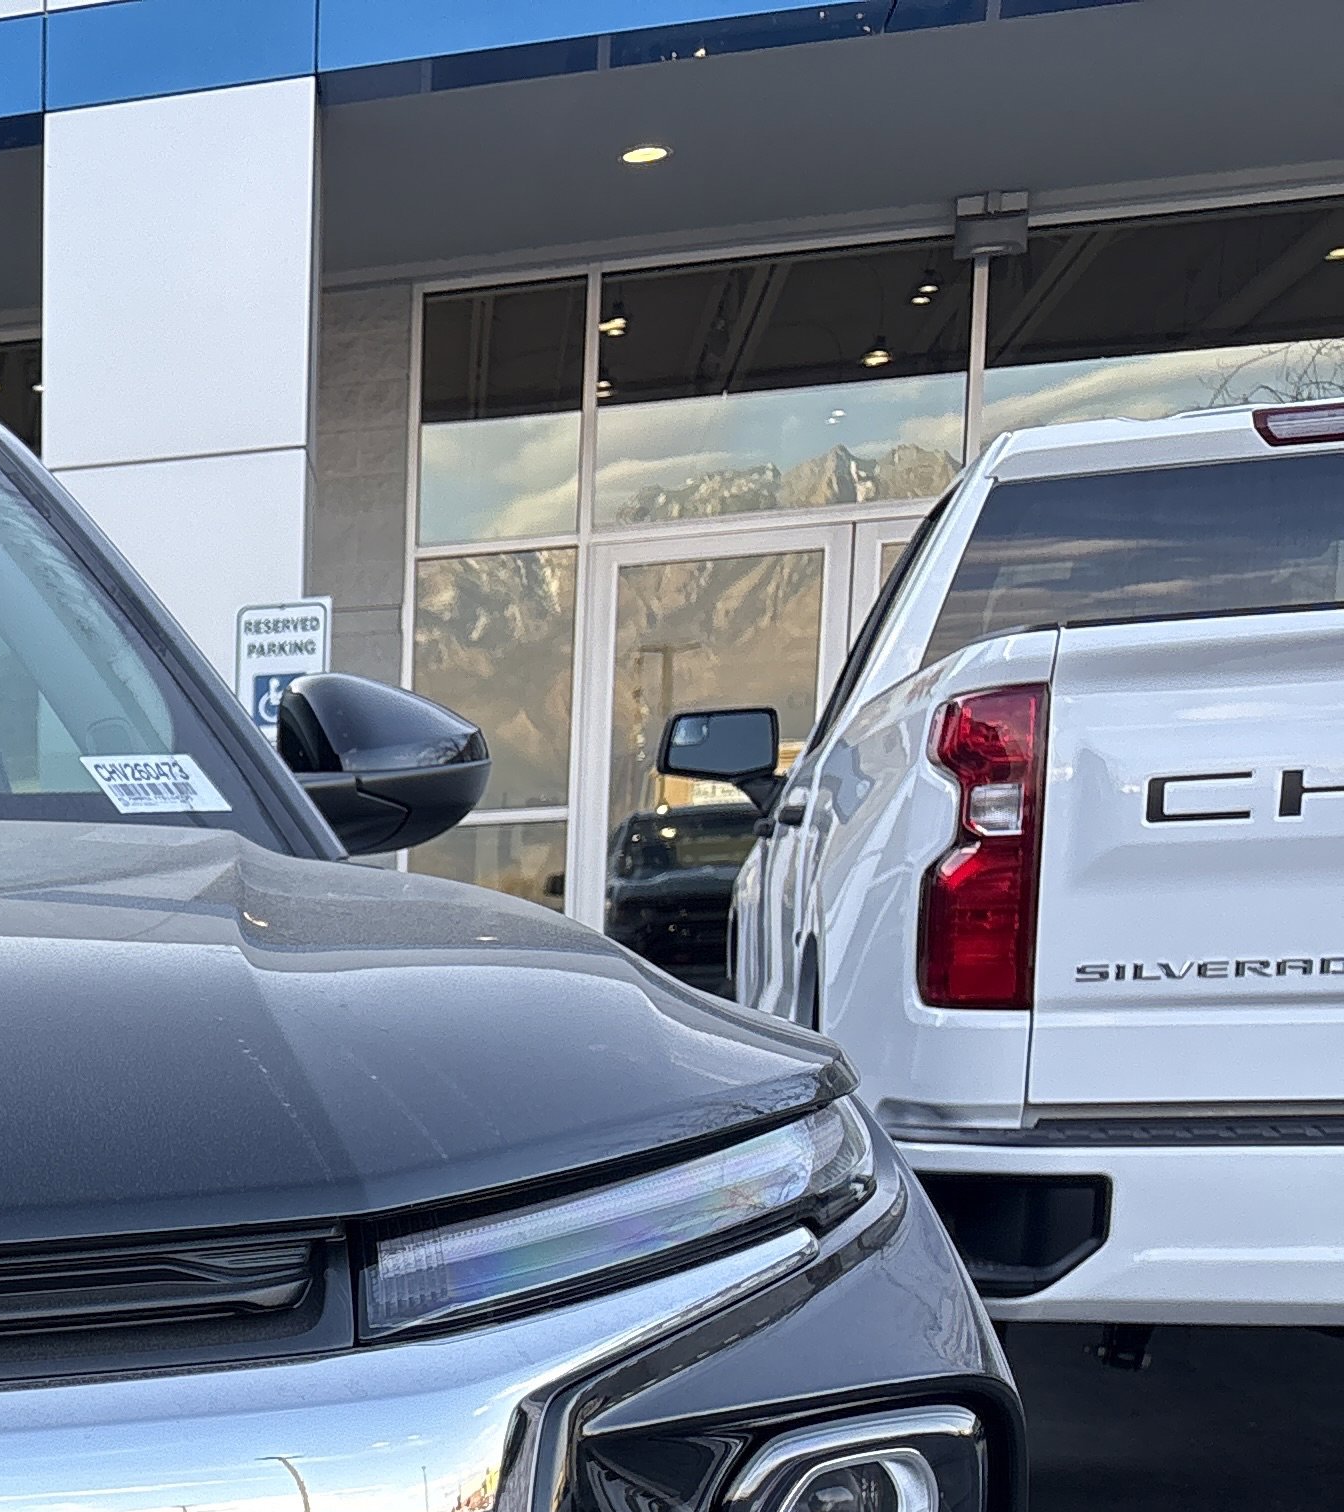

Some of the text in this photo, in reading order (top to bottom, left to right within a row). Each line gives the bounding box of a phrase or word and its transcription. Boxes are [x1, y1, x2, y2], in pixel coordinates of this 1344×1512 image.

[243, 616, 321, 635] RESERVED
[246, 639, 317, 657] PARKING
[93, 761, 190, 783] CHV260473
